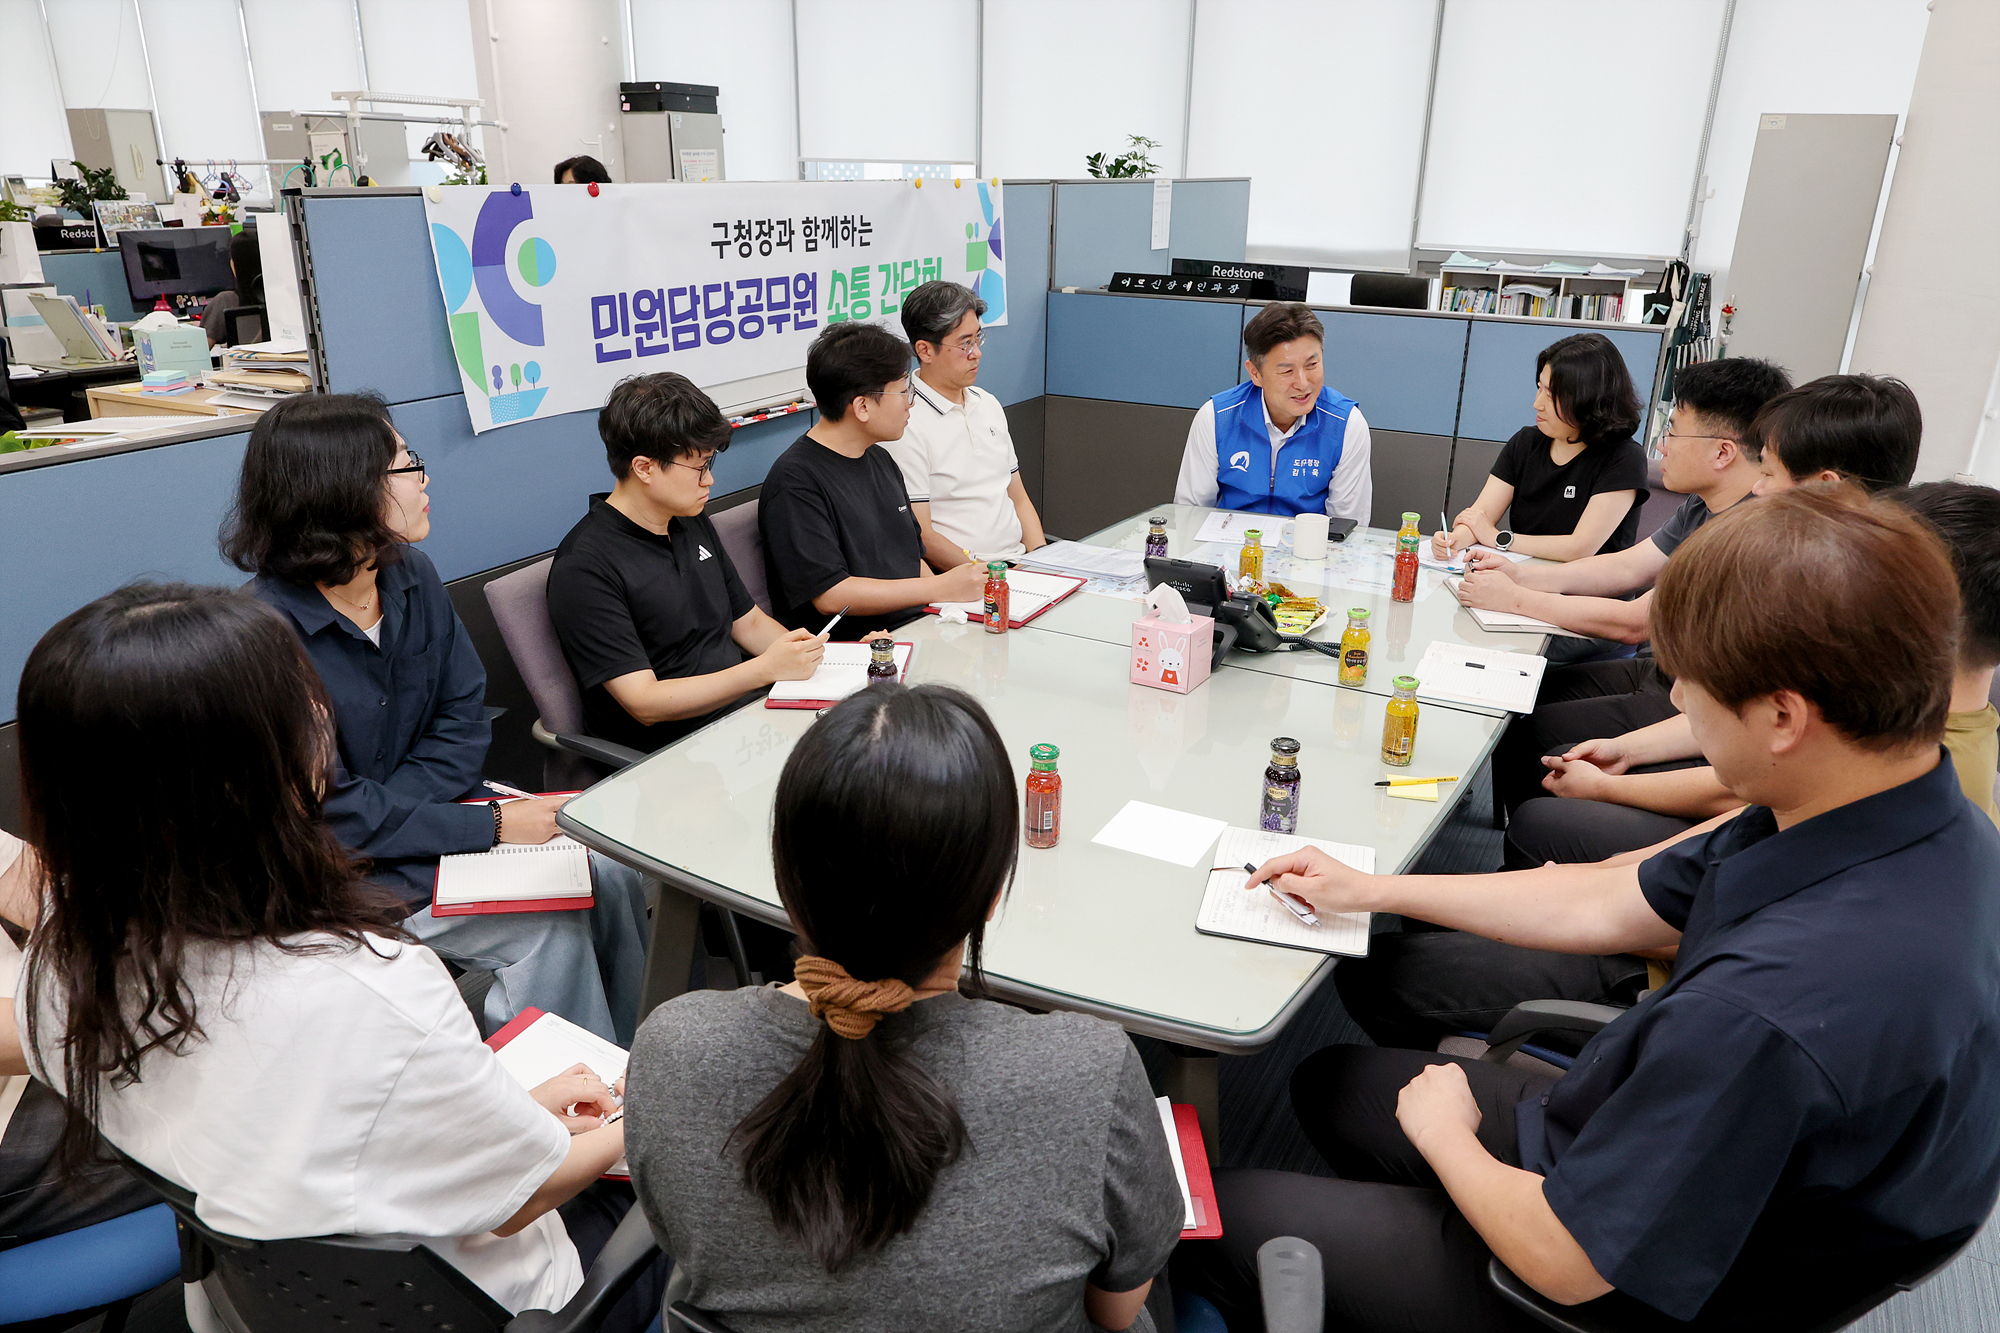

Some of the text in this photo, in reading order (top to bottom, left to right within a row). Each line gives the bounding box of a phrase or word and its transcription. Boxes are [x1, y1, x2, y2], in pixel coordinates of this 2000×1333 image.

[710, 213, 873, 259] 구청장과 함께하는
[1212, 264, 1264, 280] Redstone
[590, 271, 819, 364] 민원담당공무원
[827, 265, 872, 324] 소통
